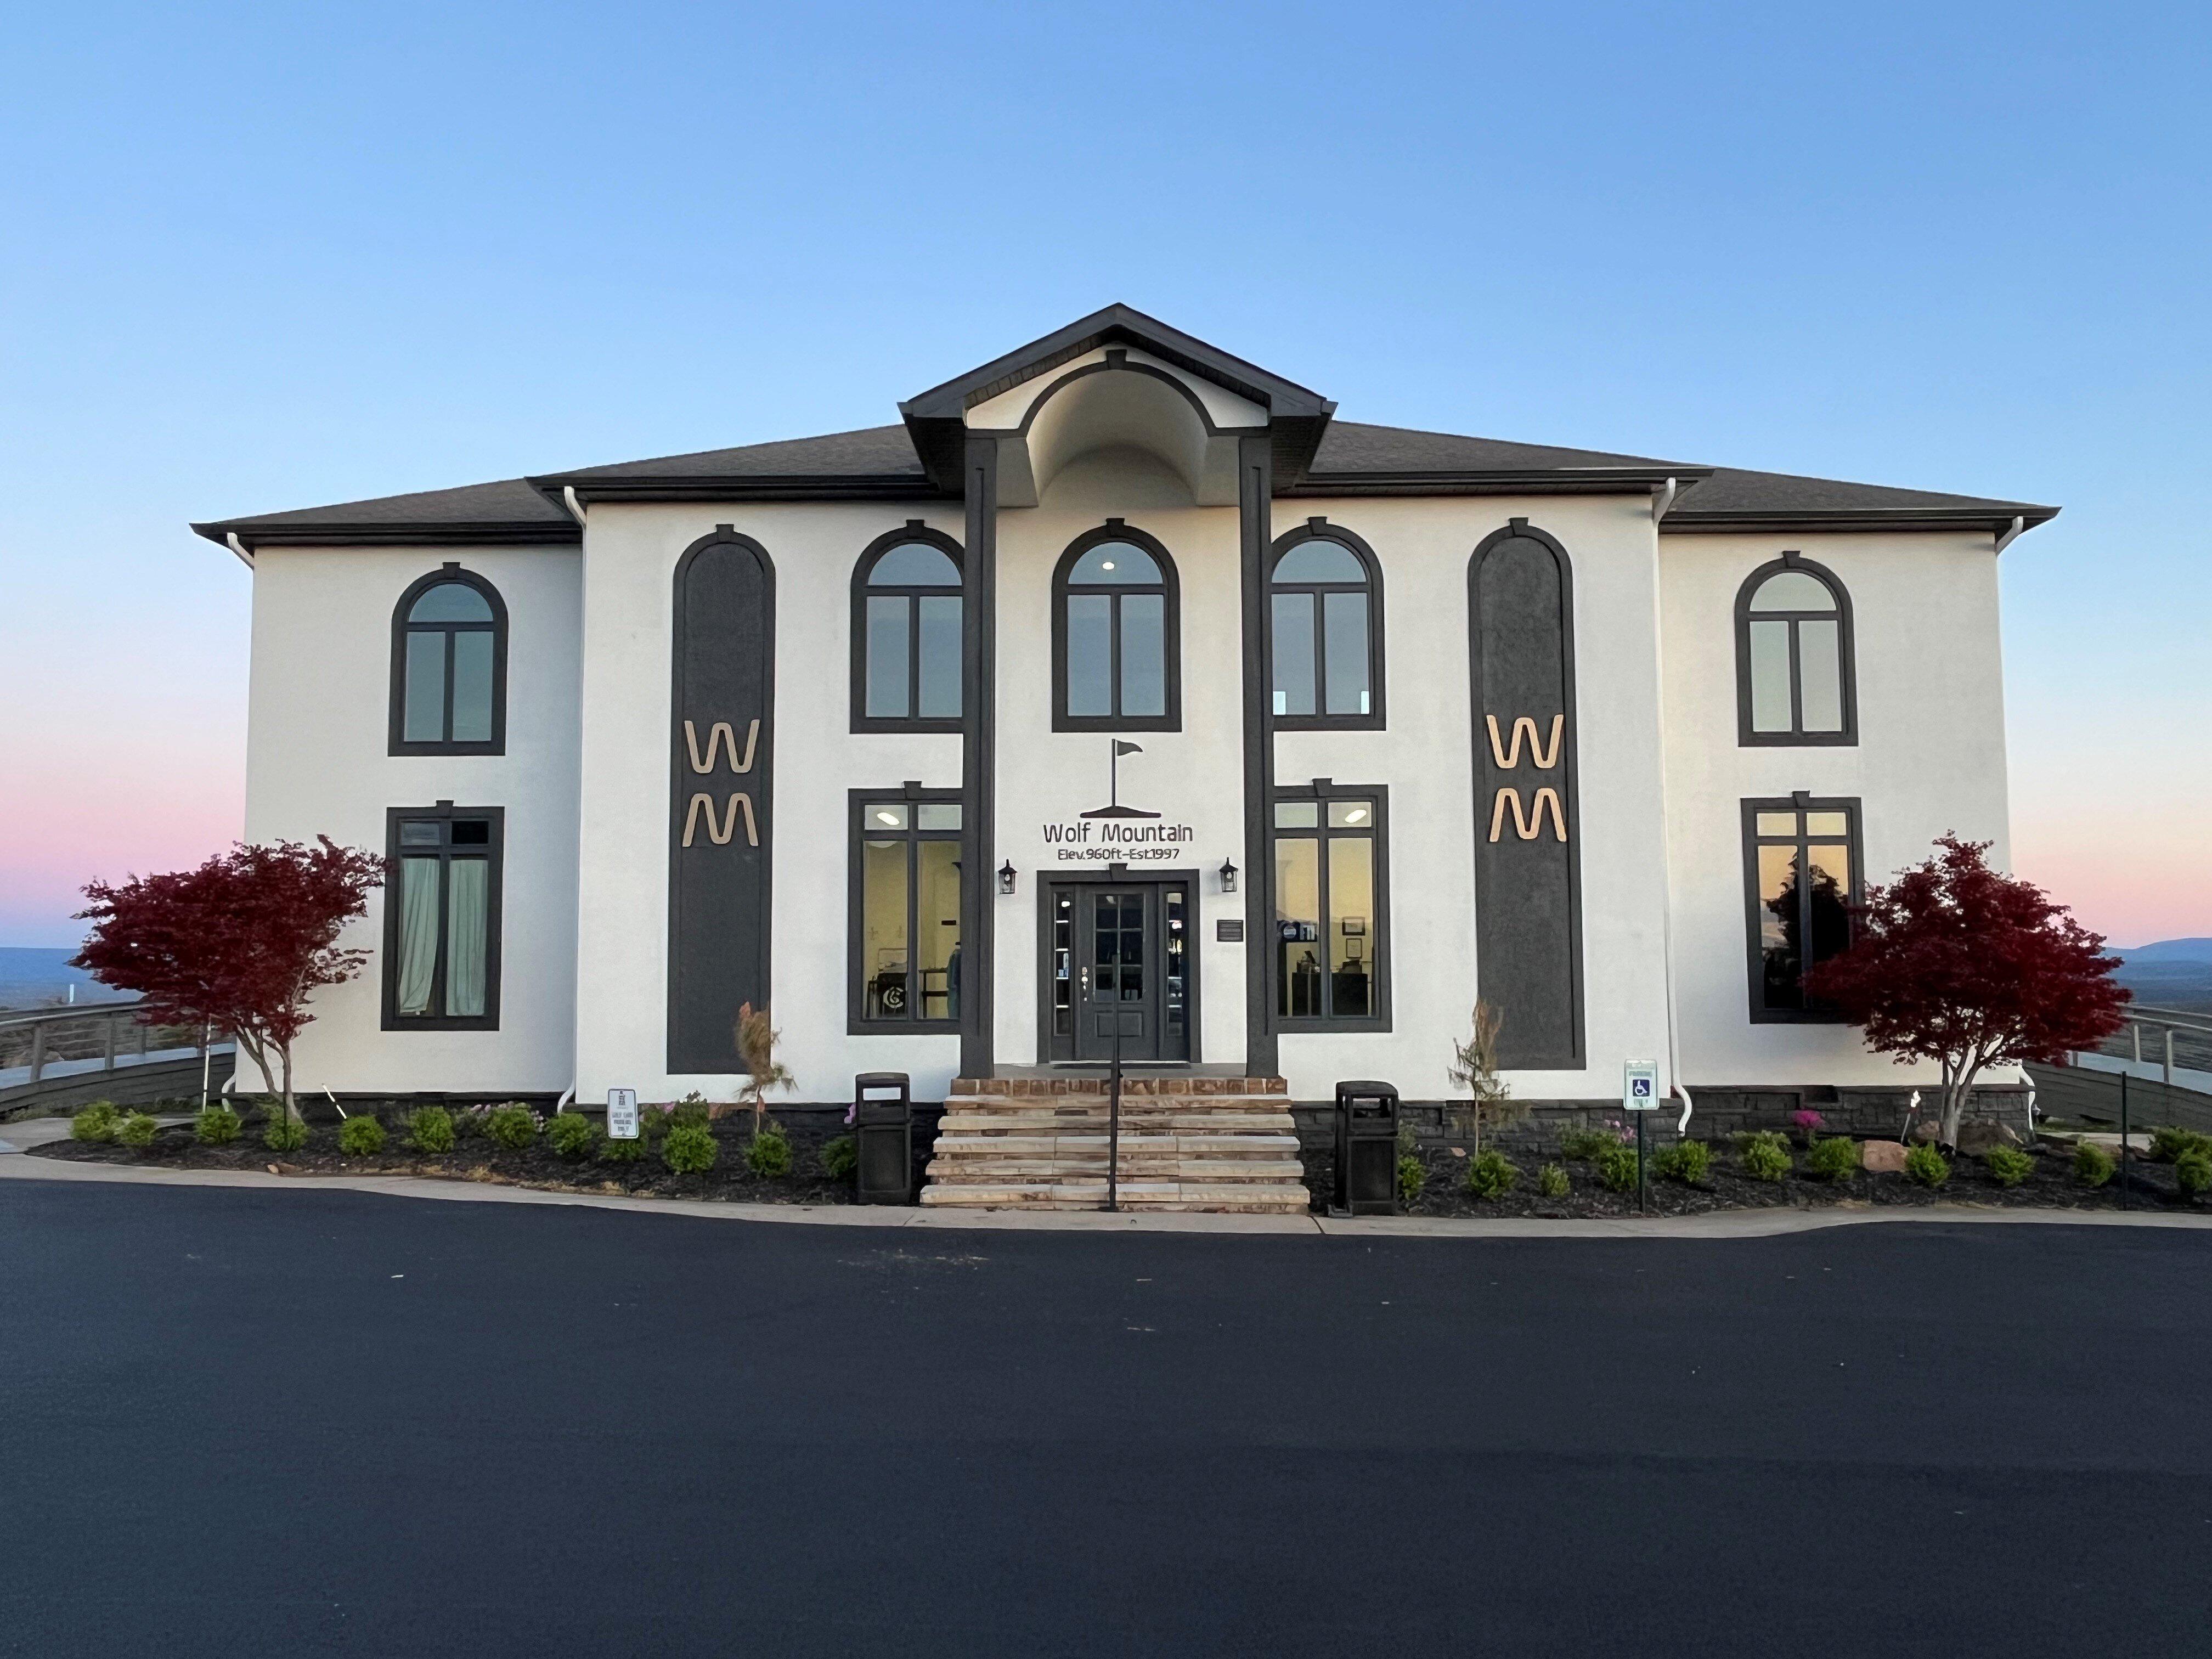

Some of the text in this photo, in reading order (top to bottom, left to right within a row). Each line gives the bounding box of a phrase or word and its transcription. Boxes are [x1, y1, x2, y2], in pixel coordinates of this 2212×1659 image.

[684, 719, 760, 774] W
[1486, 714, 1564, 769] W
[682, 793, 759, 848] M
[1043, 822, 1193, 843] Wolf Mountain
[1489, 787, 1567, 843] M
